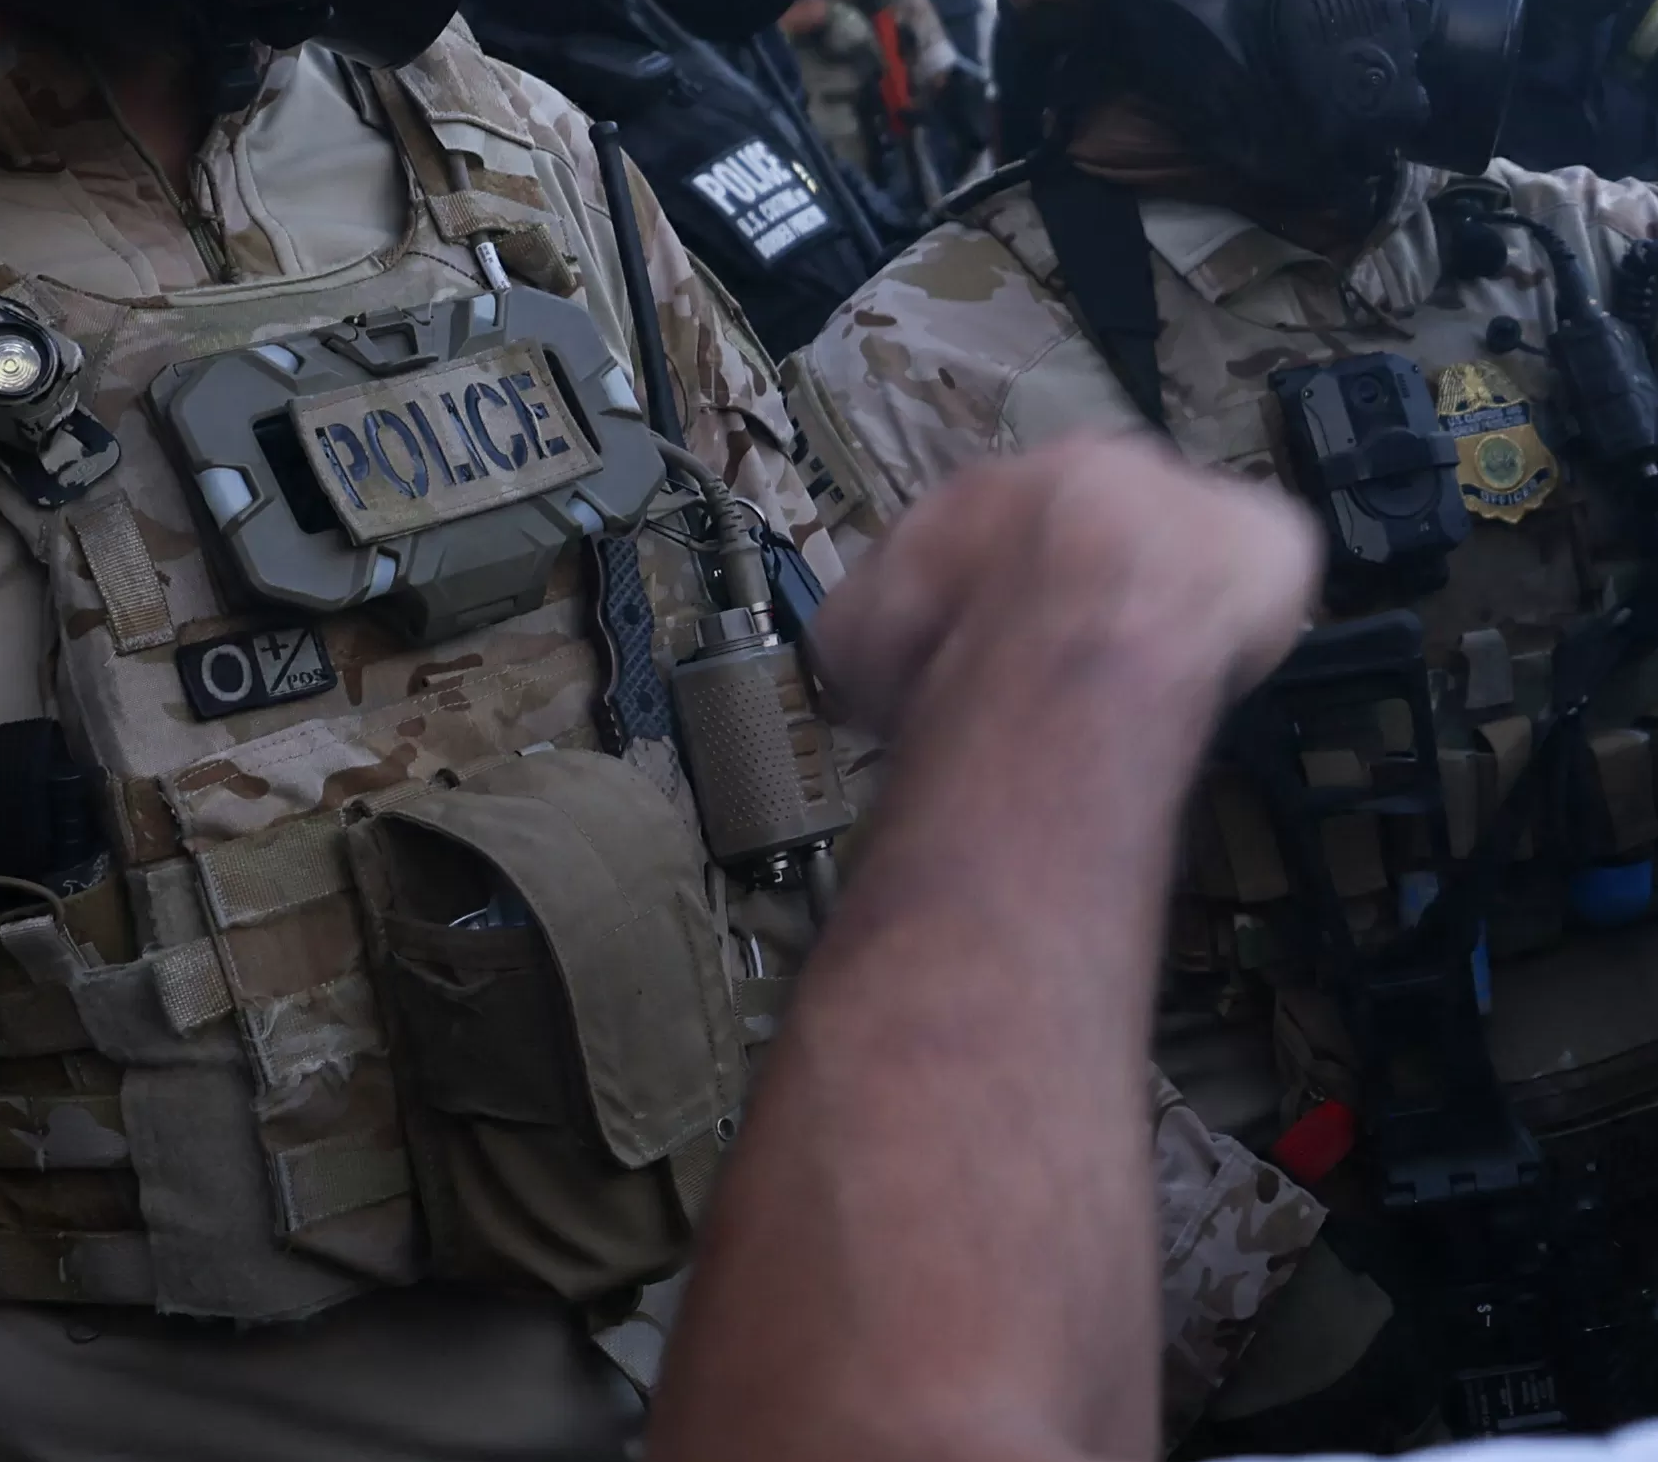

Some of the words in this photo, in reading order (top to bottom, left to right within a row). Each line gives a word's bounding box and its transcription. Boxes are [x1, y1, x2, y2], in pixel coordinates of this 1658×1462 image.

[693, 140, 792, 216] POLICE
[315, 370, 571, 510] POLICE
[201, 644, 253, 702] O
[286, 668, 330, 690] POS
